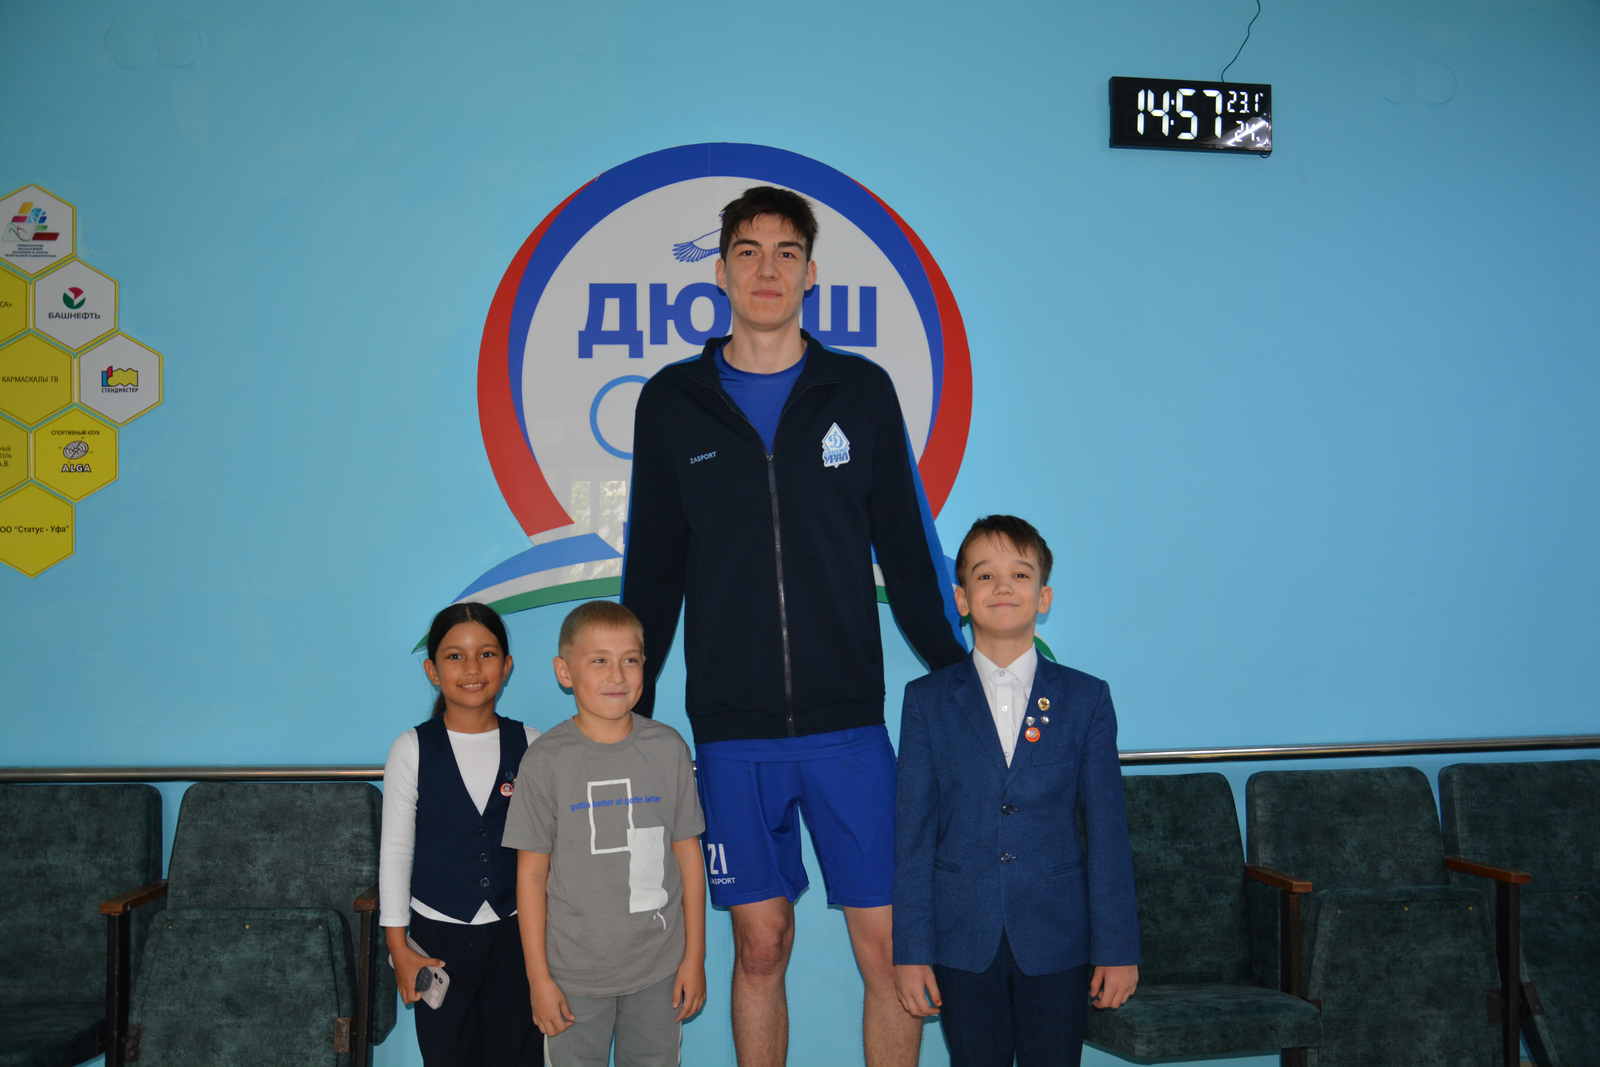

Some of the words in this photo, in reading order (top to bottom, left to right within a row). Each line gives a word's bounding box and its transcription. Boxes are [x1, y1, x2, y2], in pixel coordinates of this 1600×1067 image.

[1137, 88, 1223, 140] 14:57
[48, 311, 101, 320] БАШНЕФТЬ
[578, 282, 877, 358] ДЮШ
[689, 450, 717, 464] ZASPORT
[823, 451, 849, 465] УРАЛ
[61, 463, 92, 473] ALGA
[570, 801, 591, 813] gettin
[592, 799, 614, 808] better
[615, 798, 623, 806] at
[624, 796, 644, 807] gettin
[645, 795, 662, 803] better
[707, 843, 728, 875] 21
